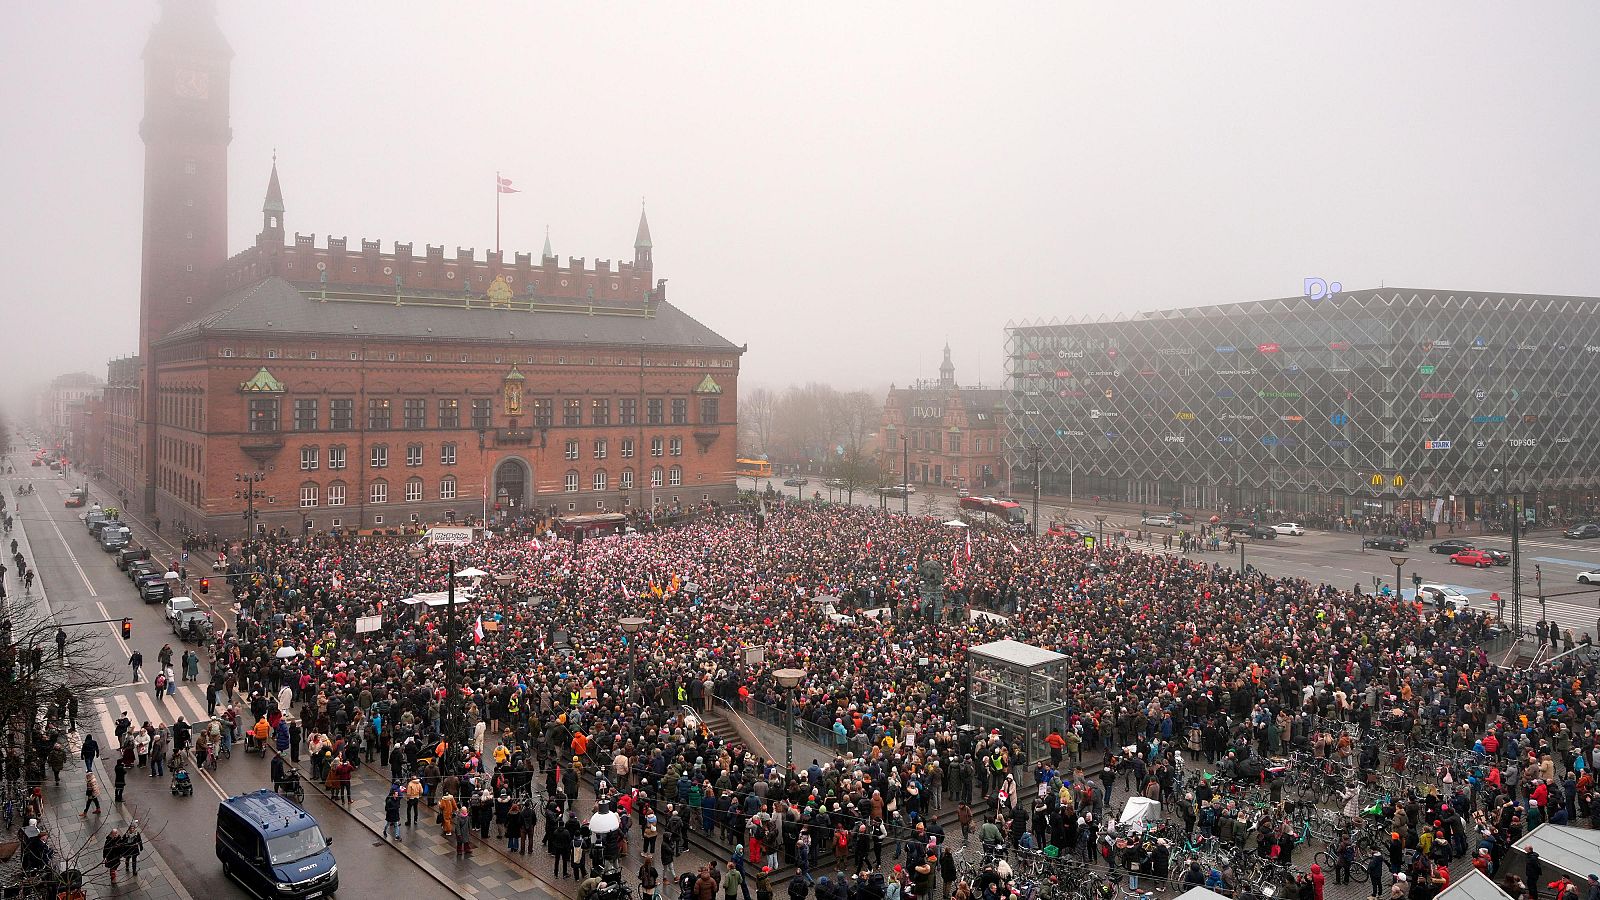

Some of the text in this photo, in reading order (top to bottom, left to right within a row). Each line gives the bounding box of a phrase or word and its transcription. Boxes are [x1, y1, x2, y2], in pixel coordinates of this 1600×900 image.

[1059, 350, 1083, 358] Ørsted
[911, 406, 941, 418] TIVOLI
[1509, 439, 1536, 447] TOPSOE
